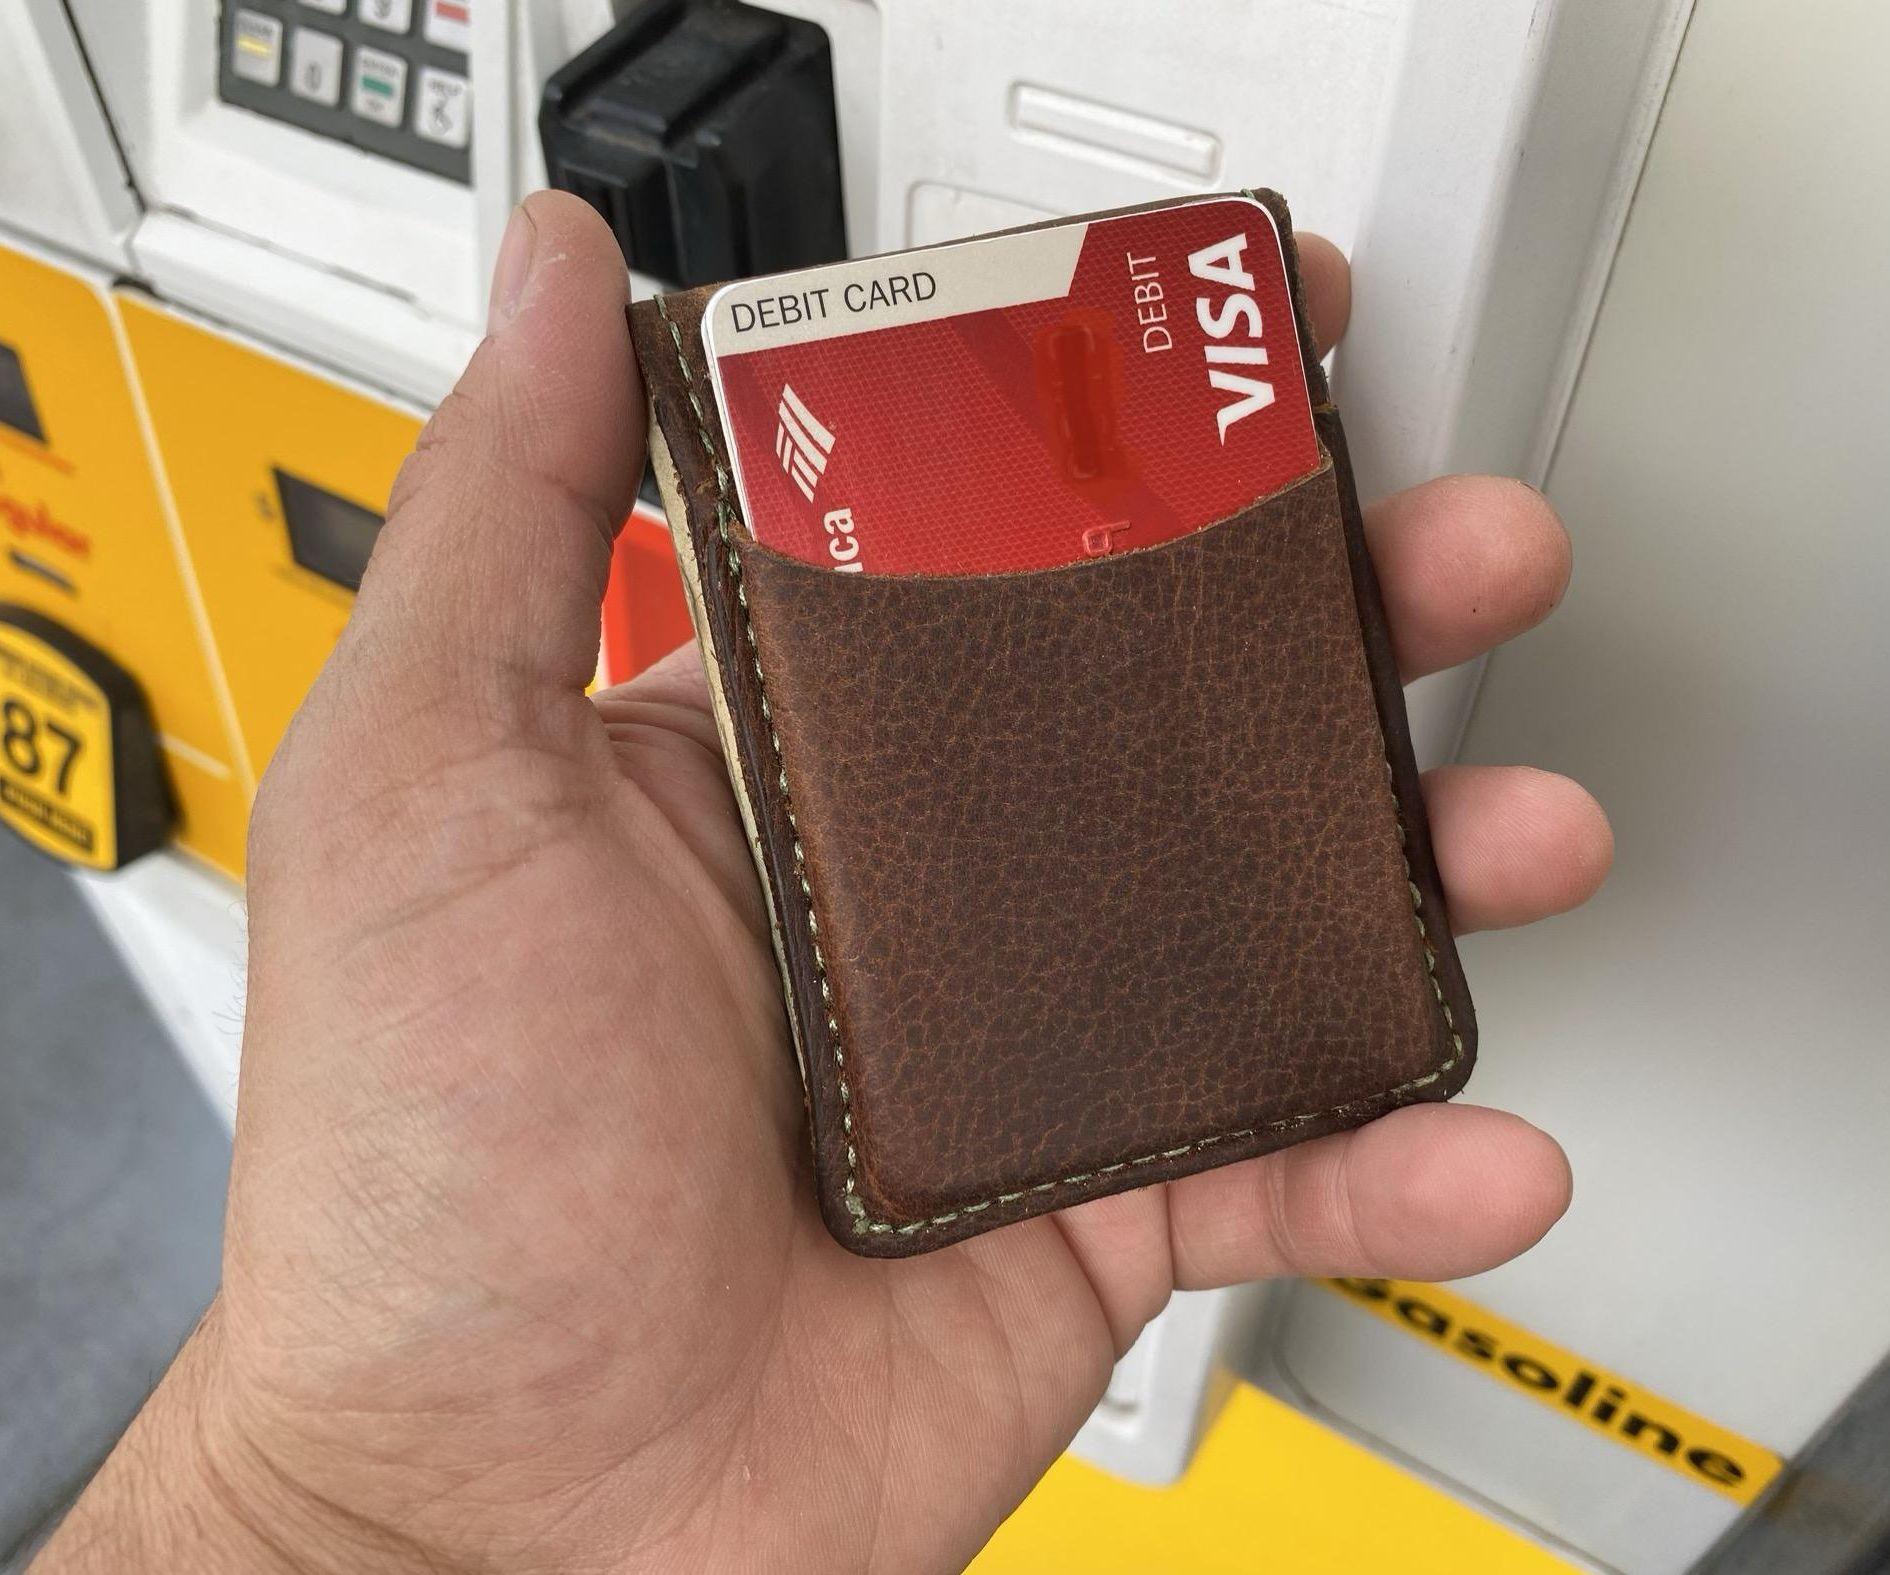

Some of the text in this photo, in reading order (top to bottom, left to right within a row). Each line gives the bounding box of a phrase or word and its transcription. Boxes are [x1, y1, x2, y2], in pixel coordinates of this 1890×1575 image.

[731, 271, 938, 334] DEBIT CARD
[1126, 251, 1174, 354] DEBIT
[1187, 232, 1277, 447] VISA
[2, 698, 84, 796] 87
